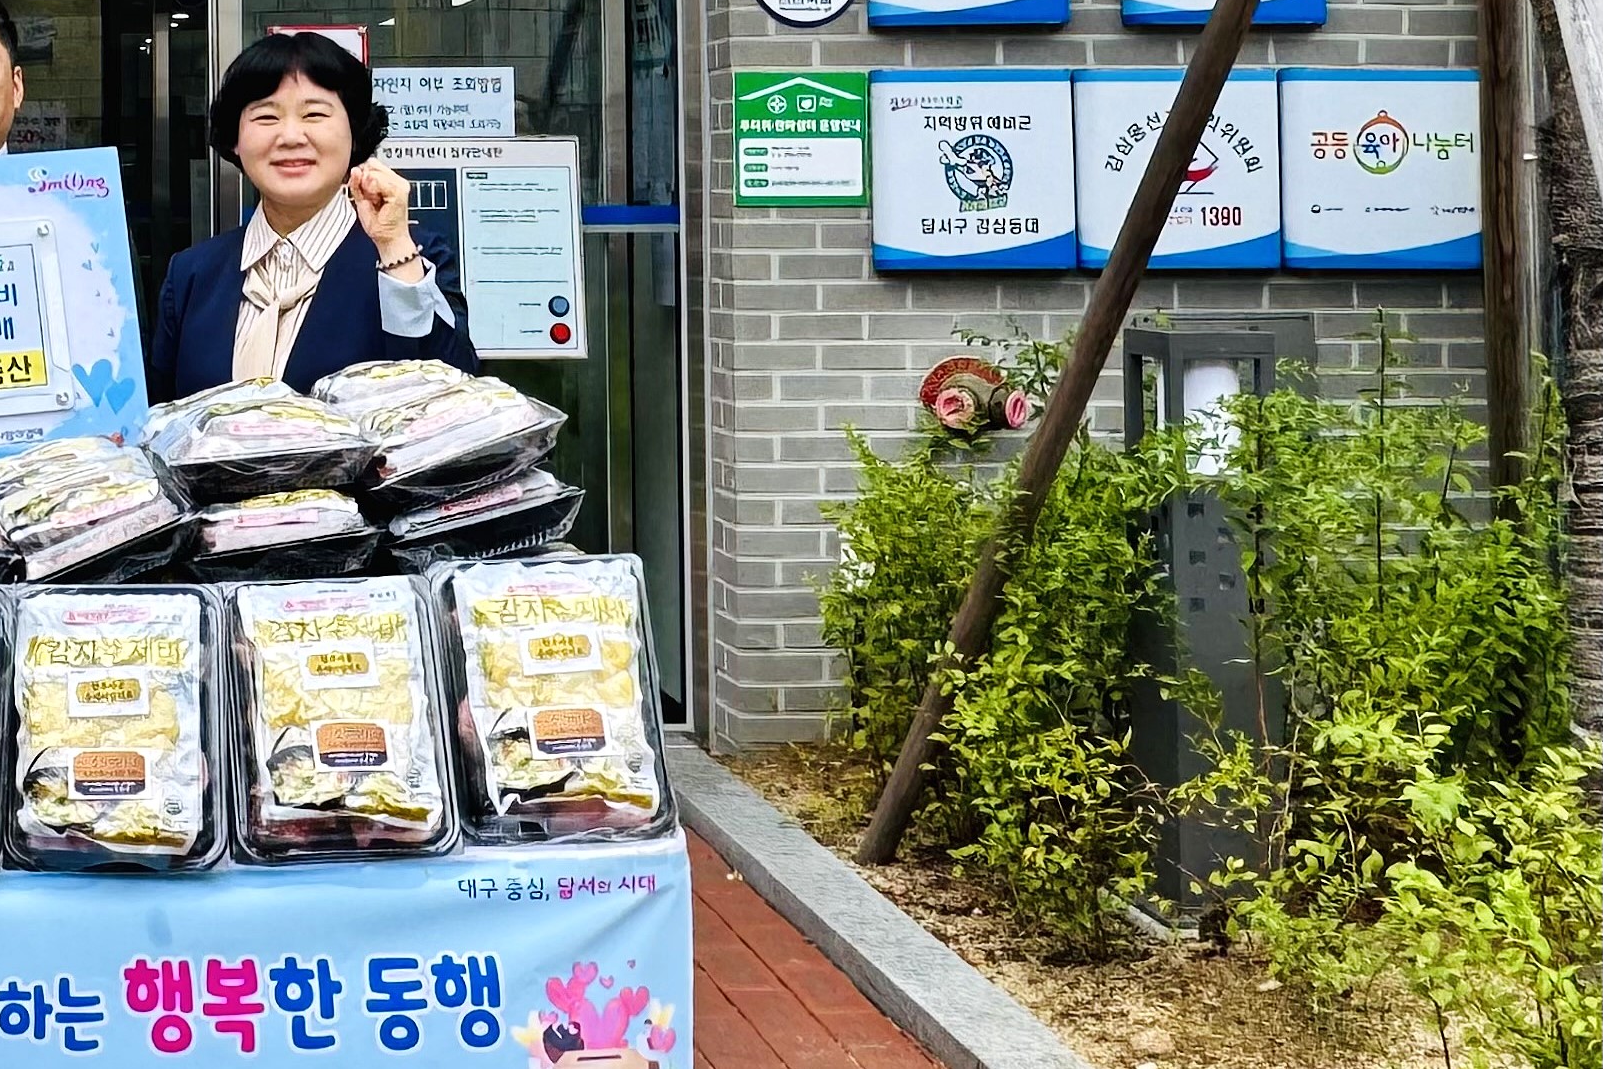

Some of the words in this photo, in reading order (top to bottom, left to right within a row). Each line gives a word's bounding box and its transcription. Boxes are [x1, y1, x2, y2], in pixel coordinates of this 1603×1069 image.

[457, 877, 499, 899] 대구
[505, 877, 550, 901] 중심,
[557, 876, 612, 900] 달서의
[618, 874, 656, 894] 시대
[123, 953, 343, 1055] 행복한
[365, 952, 502, 1051] 동행
